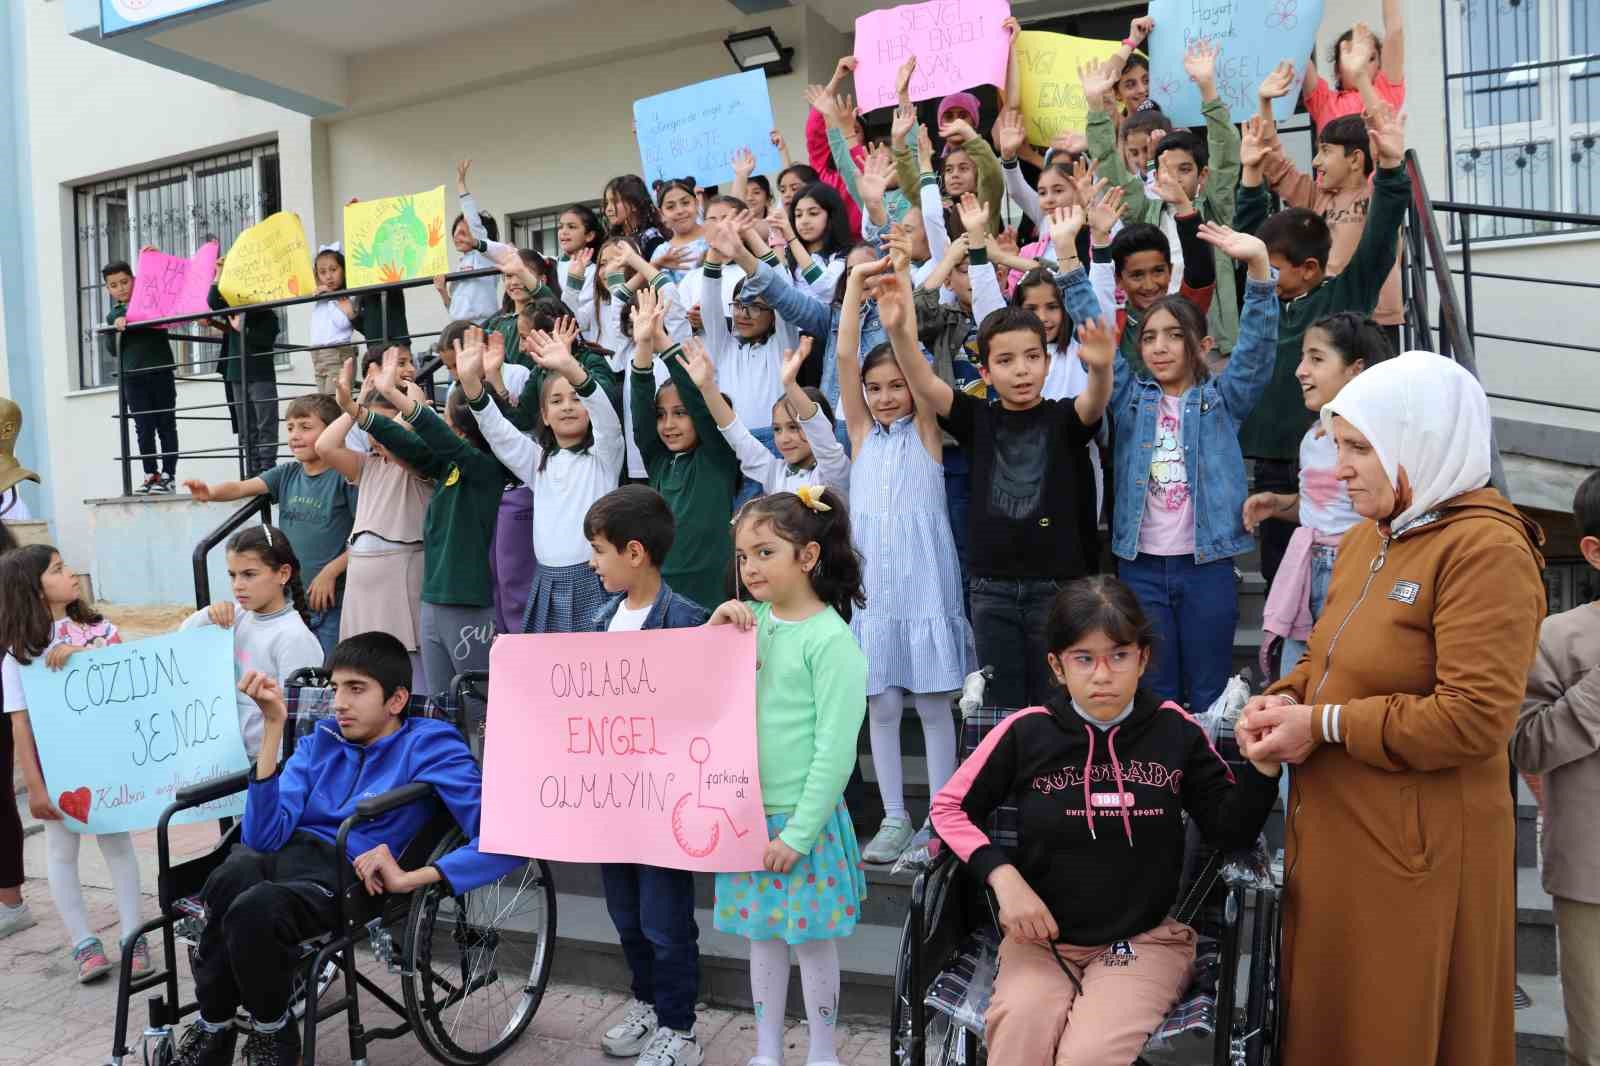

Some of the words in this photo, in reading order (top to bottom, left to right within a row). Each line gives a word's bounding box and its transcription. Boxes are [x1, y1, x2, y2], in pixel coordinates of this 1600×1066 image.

[877, 33, 912, 65] HER
[64, 647, 190, 716] ÇÖZÜM
[551, 657, 657, 699] ONLARA
[567, 715, 668, 756] ENGEL
[540, 771, 676, 813] OLMAYIN
[1133, 808, 1165, 817] SPORTS
